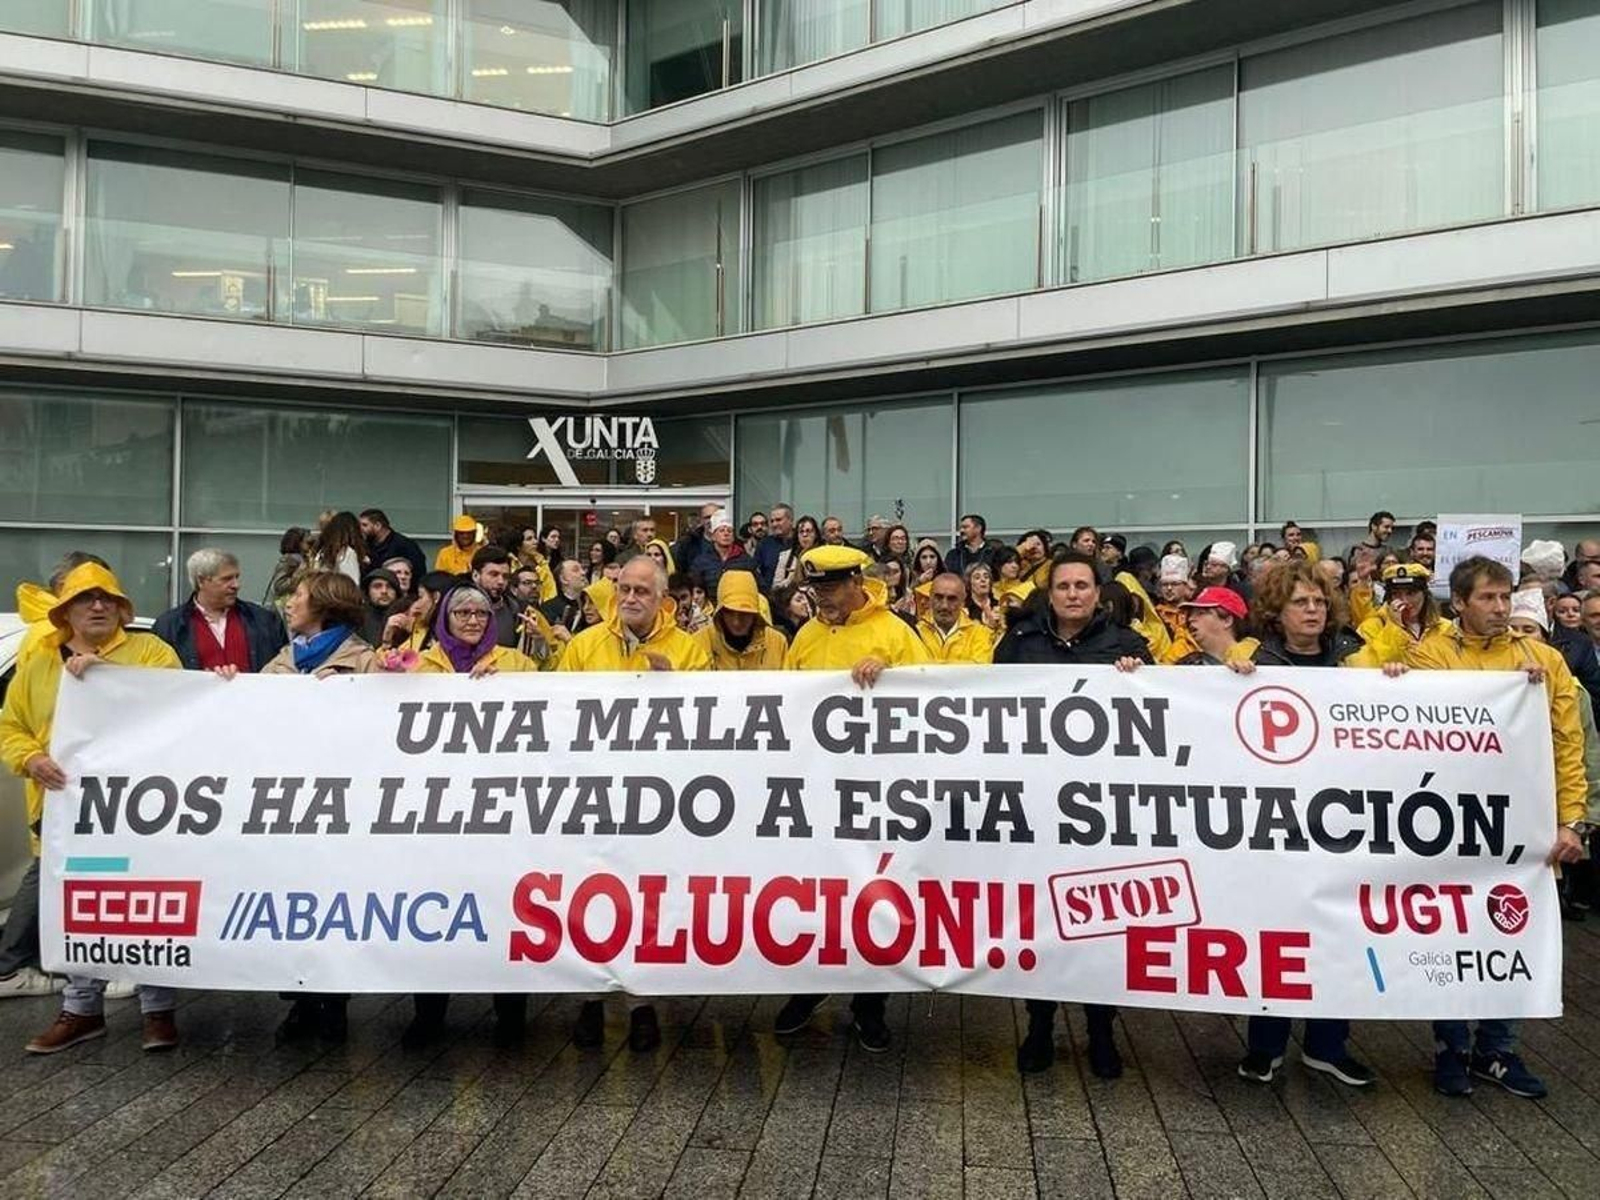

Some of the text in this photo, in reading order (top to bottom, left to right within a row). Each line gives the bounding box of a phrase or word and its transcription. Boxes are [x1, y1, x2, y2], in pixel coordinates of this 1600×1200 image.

[526, 416, 660, 488] XUNTA
[567, 449, 635, 460] DE GALICIA
[396, 678, 1192, 767] UNA MALA GESTIÓN,
[1329, 703, 1496, 726] GRUPO NUEVA
[1333, 726, 1503, 754] PESCANOVA
[74, 771, 1526, 866] NOS HA LLEVADO A ESTA SITUACIÓN,
[71, 890, 188, 923] CCOO
[508, 852, 1037, 973] SOLUCIÓN!!
[1065, 875, 1181, 926] STOP
[1358, 884, 1474, 935] UGT
[64, 934, 192, 967] industria
[1126, 925, 1314, 1001] ERE
[1408, 950, 1453, 966] Galicia
[1455, 949, 1533, 983] FICA
[1425, 969, 1454, 986] Vigo
